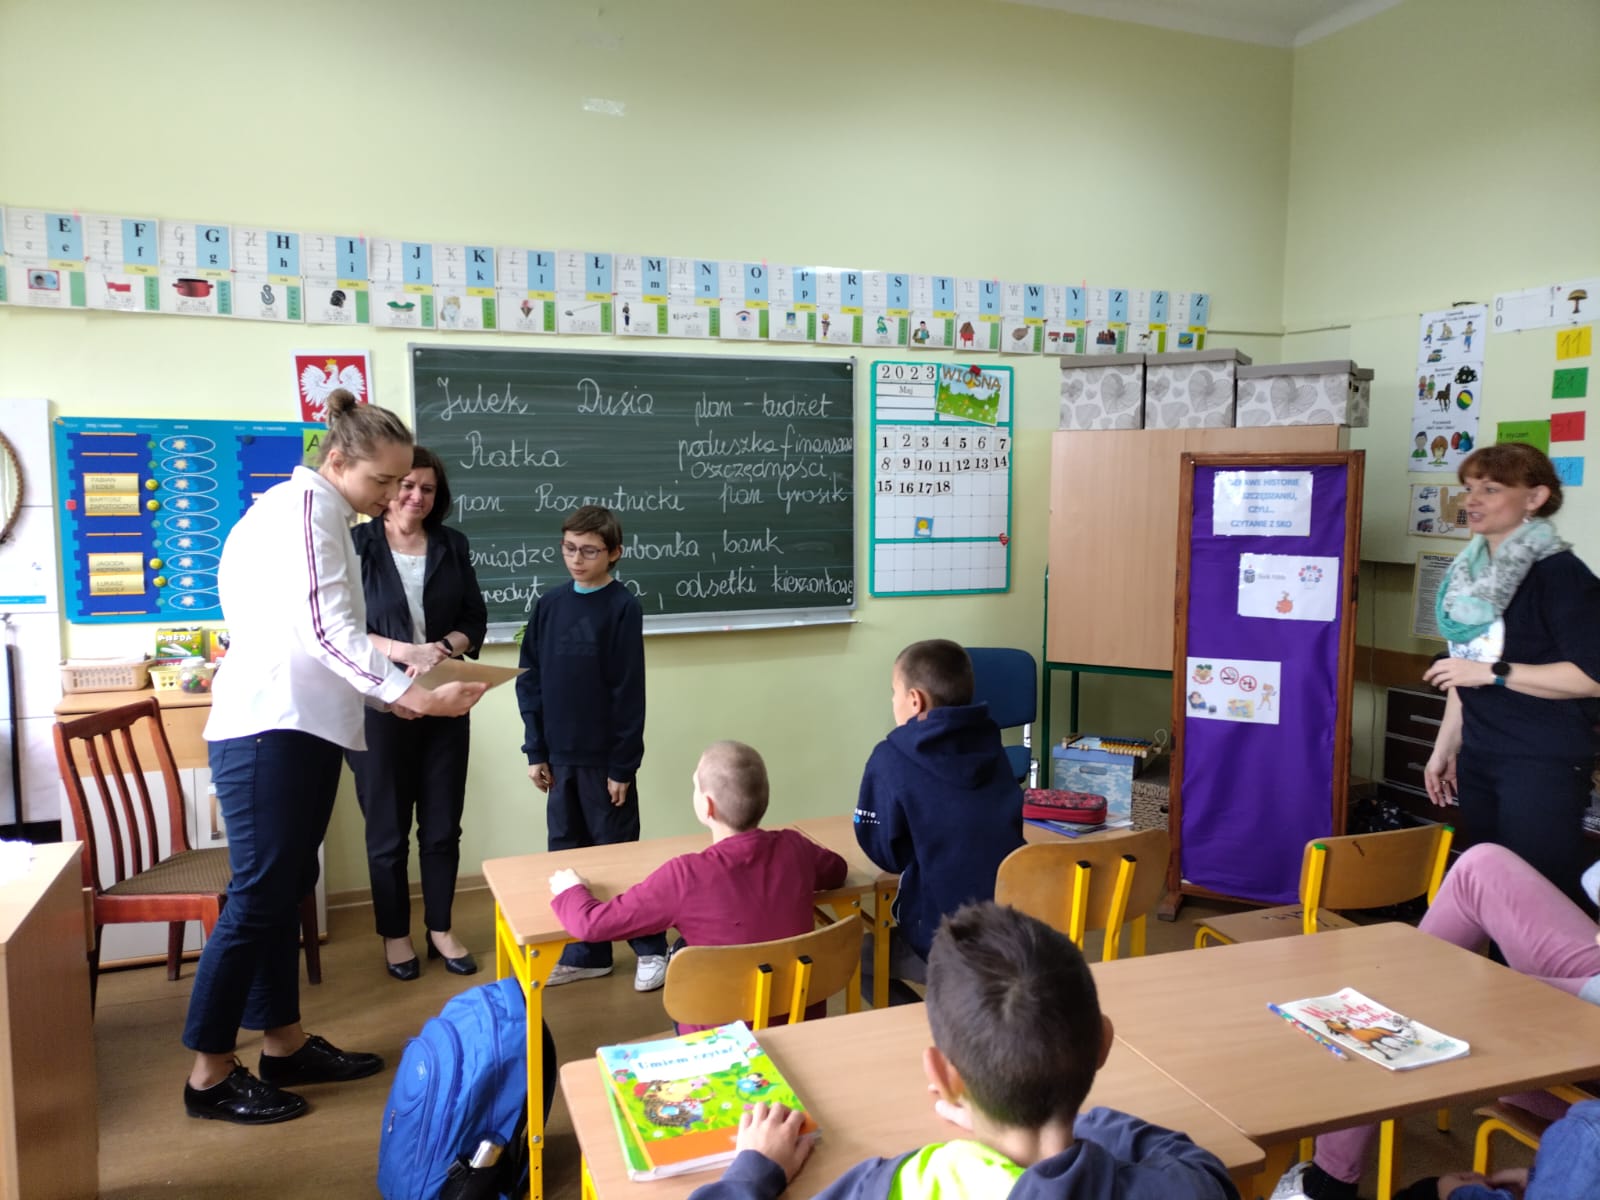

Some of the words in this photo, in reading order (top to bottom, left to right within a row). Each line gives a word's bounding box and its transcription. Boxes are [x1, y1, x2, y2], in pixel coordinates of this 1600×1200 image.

[58, 218, 72, 233] E
[134, 222, 146, 238] F
[205, 228, 220, 243] G
[62, 243, 70, 252] e
[276, 234, 290, 250] H
[348, 240, 354, 254] I
[413, 246, 421, 259] J
[474, 250, 486, 263] K
[209, 253, 218, 265] g
[280, 257, 288, 268] h
[536, 254, 547, 267] L
[594, 256, 604, 269] Ł
[350, 262, 354, 273] i
[648, 260, 662, 272] M
[701, 263, 711, 275] N
[416, 267, 421, 280] j
[477, 270, 484, 281] k
[751, 266, 762, 279] O
[801, 271, 809, 281] P
[540, 274, 543, 284] l
[650, 281, 660, 289] m
[848, 274, 857, 285] R
[894, 276, 902, 287] S
[939, 279, 948, 290] T
[704, 284, 711, 292] n
[754, 287, 760, 295] o
[802, 289, 809, 299] p
[986, 283, 994, 294] U
[1028, 287, 1040, 297] W
[1072, 289, 1081, 299] Y
[1114, 291, 1123, 302] Z
[1073, 309, 1078, 317] y
[942, 366, 1001, 391] WIOSNA
[437, 377, 529, 421] Julek
[577, 378, 655, 416] Dusia
[694, 392, 733, 427] plan
[762, 392, 833, 418] budżet
[882, 437, 889, 448] 1
[902, 434, 911, 447] 2
[921, 437, 929, 448] 3
[942, 436, 950, 448] 4
[959, 438, 967, 448] 5
[977, 437, 987, 449] 6
[999, 439, 1007, 449] 7
[678, 429, 779, 472] poduszka
[881, 457, 891, 470] 8
[902, 458, 911, 469] 9
[918, 460, 932, 471] 10
[938, 462, 951, 473] 11
[957, 459, 971, 471] 12
[975, 460, 989, 469] 13
[994, 456, 1008, 468] 14
[878, 481, 893, 492] 15
[899, 483, 914, 494] 16
[919, 483, 933, 494] 17
[936, 481, 951, 492] 18
[454, 494, 504, 523] pan
[719, 482, 764, 514] pan
[723, 528, 784, 554] bank
[481, 576, 545, 613] redyt
[675, 565, 757, 598] odsetki
